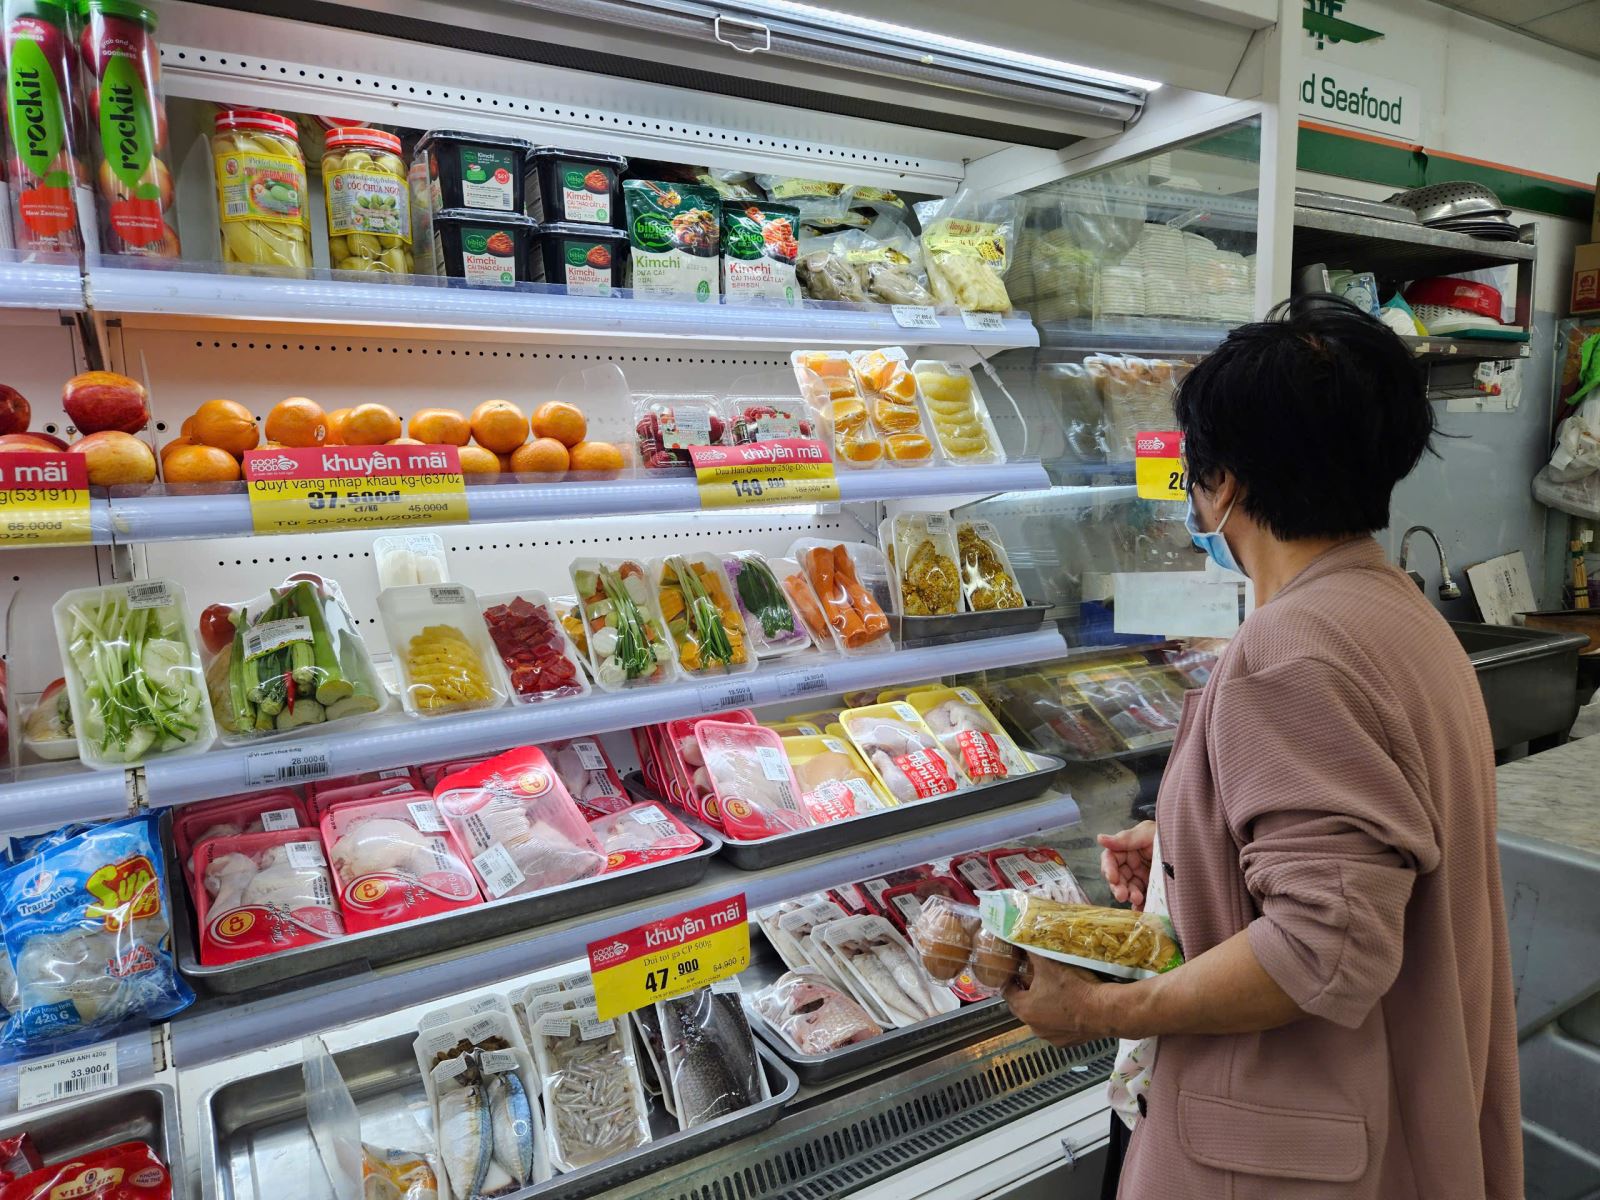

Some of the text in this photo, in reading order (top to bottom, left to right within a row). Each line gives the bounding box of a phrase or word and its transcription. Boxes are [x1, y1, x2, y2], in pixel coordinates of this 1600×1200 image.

[1321, 77, 1402, 125] Seafood
[16, 67, 48, 157] rockit
[108, 84, 140, 170] rockit
[566, 191, 593, 201] Kimchi
[636, 221, 672, 236] bibigo
[467, 255, 497, 265] Kimchi
[635, 255, 680, 269] Kimchi
[569, 267, 595, 276] Kimchi
[730, 262, 771, 275] Kimchi
[797, 444, 823, 459] mãi
[251, 458, 278, 466] COOP
[409, 451, 448, 469] mãi
[15, 461, 68, 482] mãi
[252, 464, 279, 472] FOOD
[329, 477, 362, 490] nhap
[366, 475, 397, 486] khau
[734, 802, 746, 816] CP
[362, 883, 379, 898] CP
[710, 902, 740, 927] mãi
[229, 916, 244, 932] CP
[35, 1010, 70, 1026] 420 G
[71, 1064, 102, 1079] 33.900
